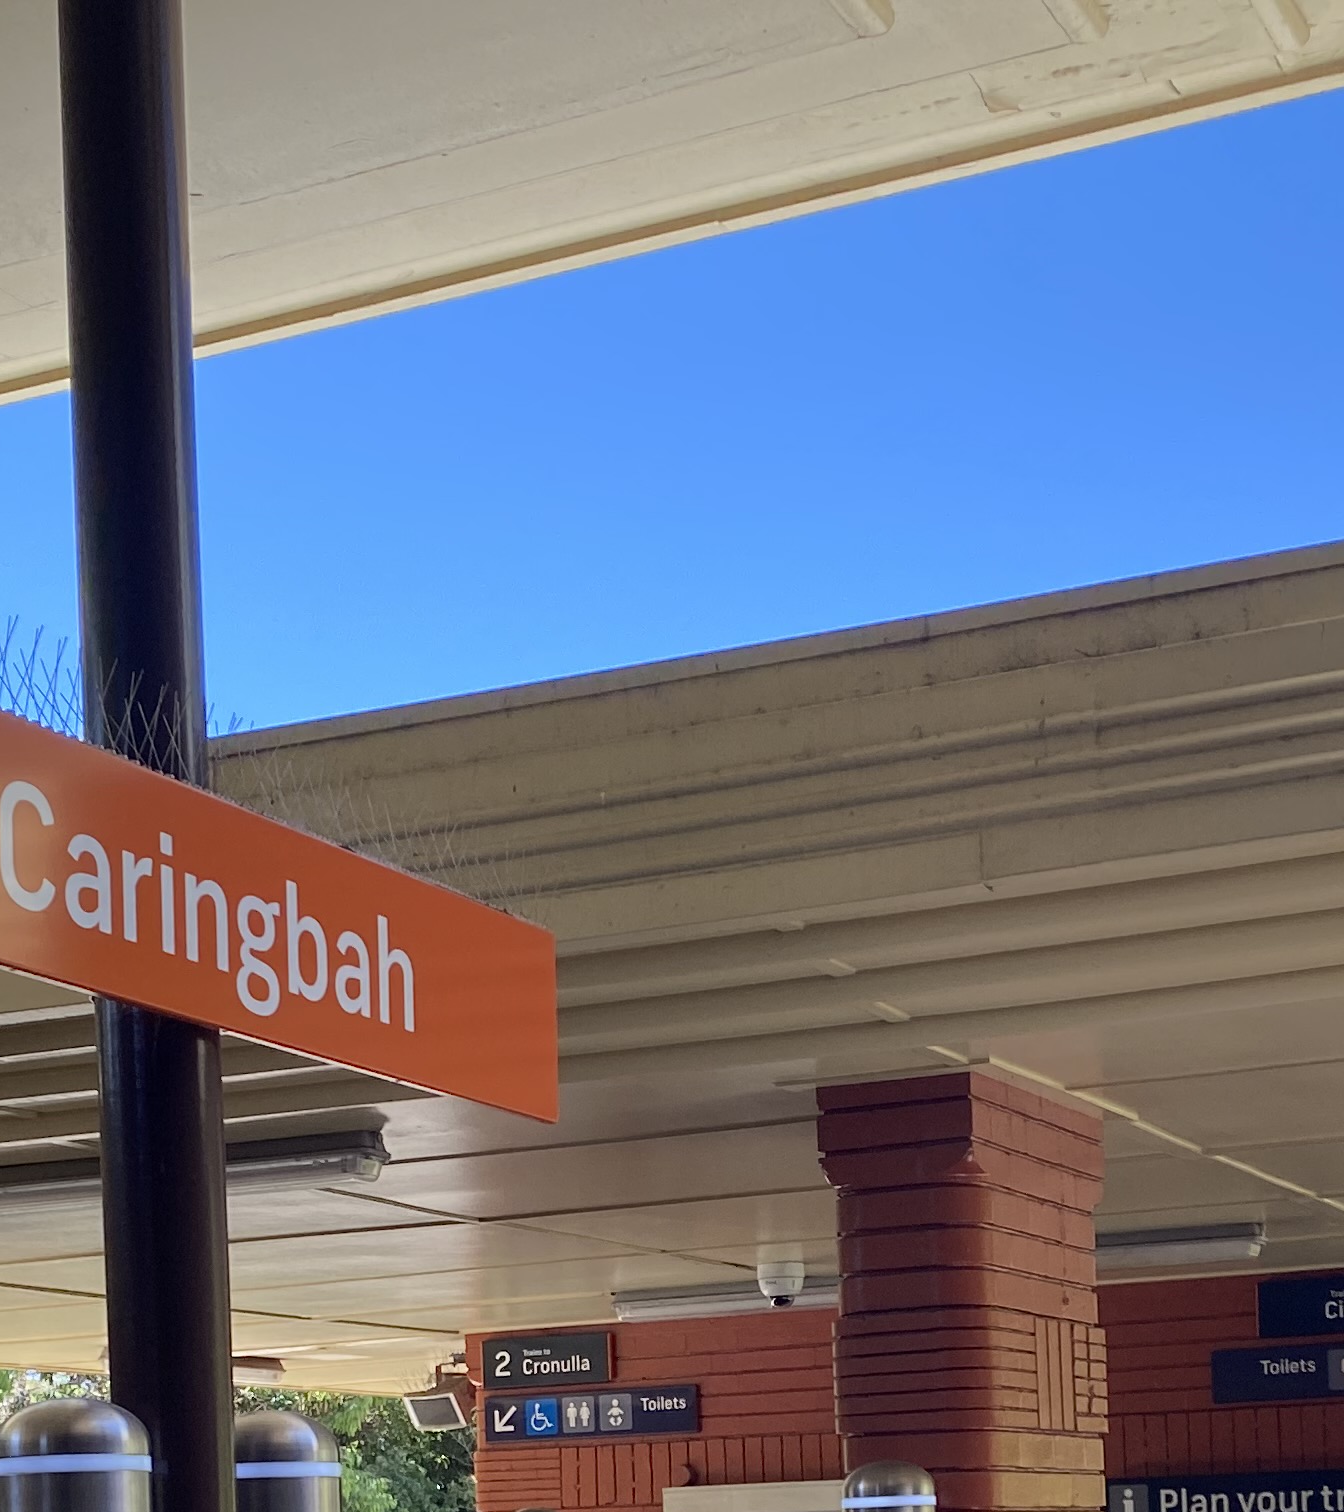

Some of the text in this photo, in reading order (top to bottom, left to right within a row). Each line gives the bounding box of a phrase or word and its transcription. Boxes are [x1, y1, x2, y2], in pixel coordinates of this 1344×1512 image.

[494, 1350, 512, 1377] 2
[522, 1355, 591, 1376] Cronulla
[1259, 1357, 1316, 1376] Toilets
[640, 1396, 687, 1412] Toilets
